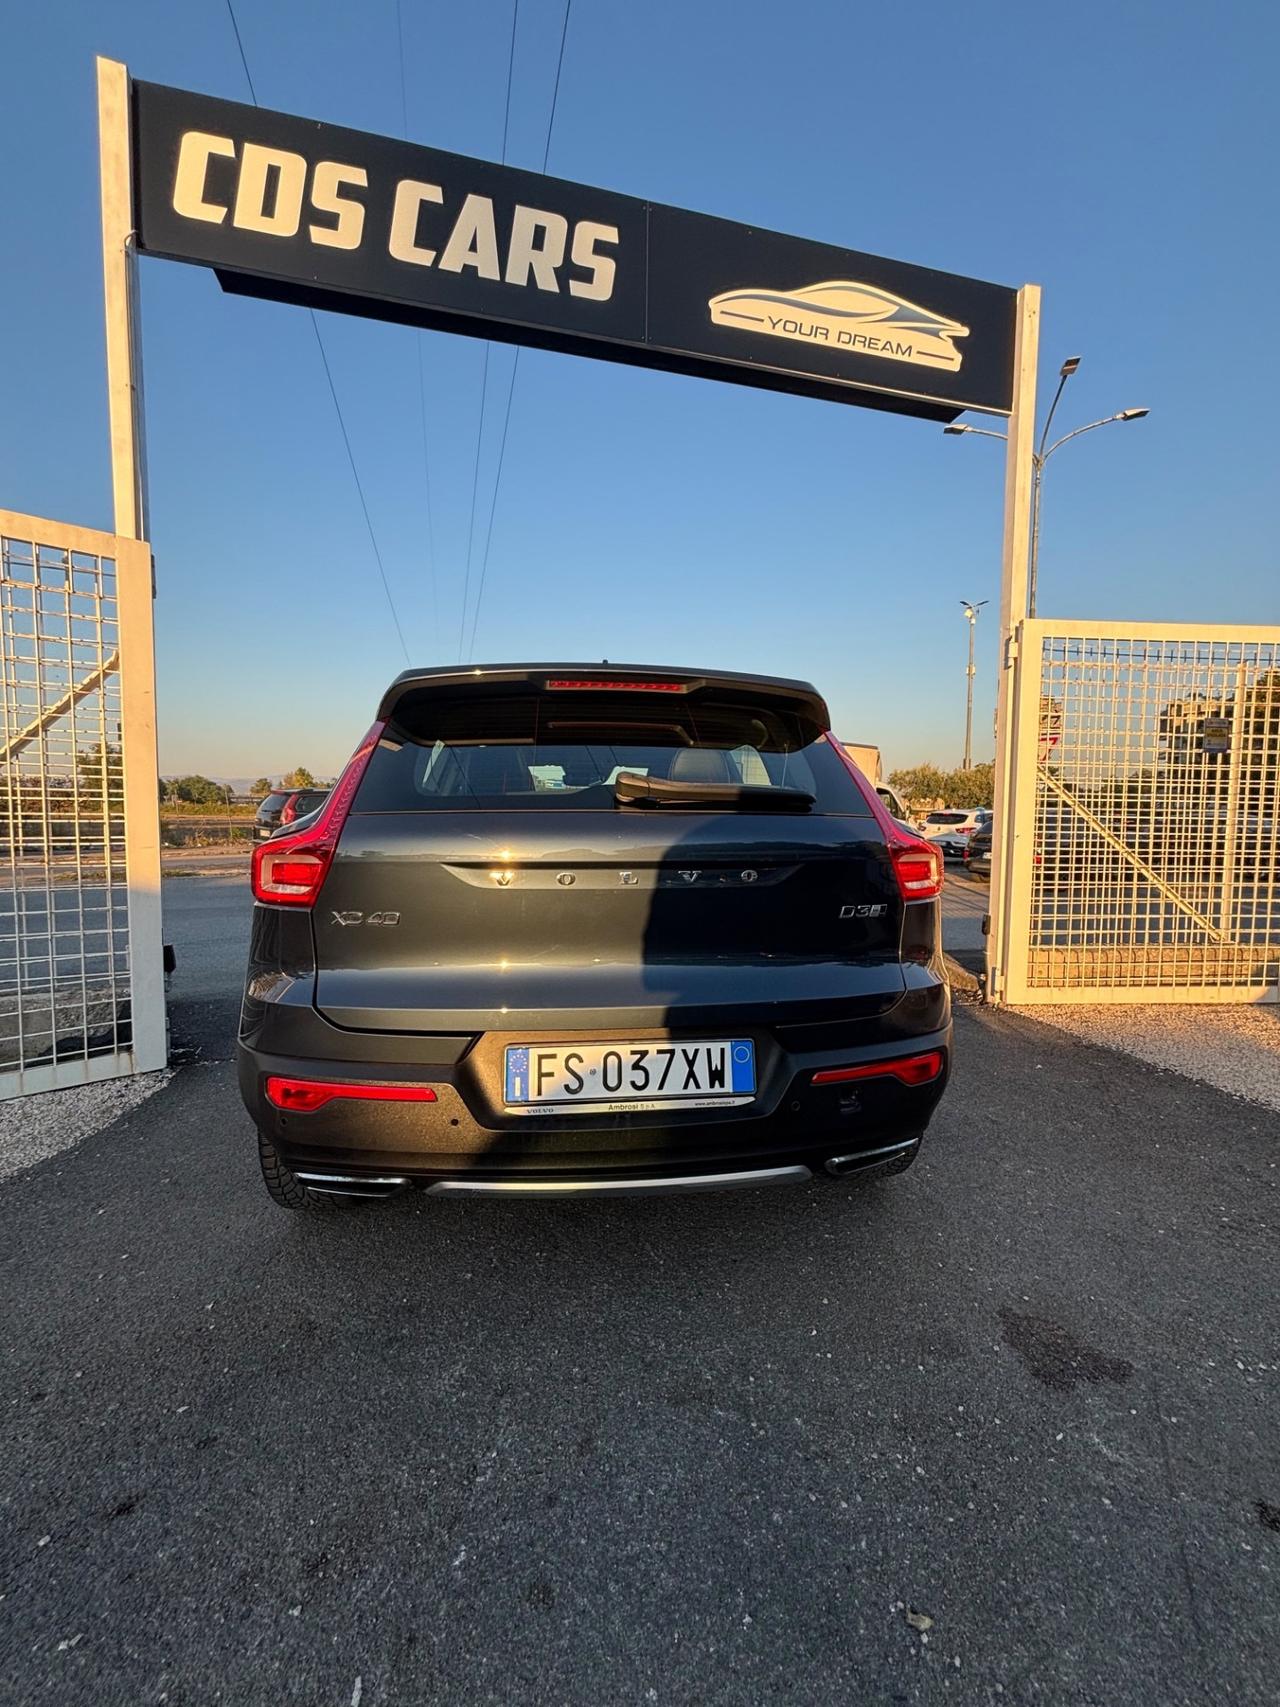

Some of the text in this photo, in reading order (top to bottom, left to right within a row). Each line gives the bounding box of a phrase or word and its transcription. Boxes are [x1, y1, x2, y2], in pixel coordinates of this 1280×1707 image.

[173, 131, 619, 301] CDS CARS
[766, 316, 913, 357] YOUR DREAM
[490, 869, 758, 886] VOLVO
[537, 1053, 584, 1096] FS
[602, 1047, 726, 1092] 037XW
